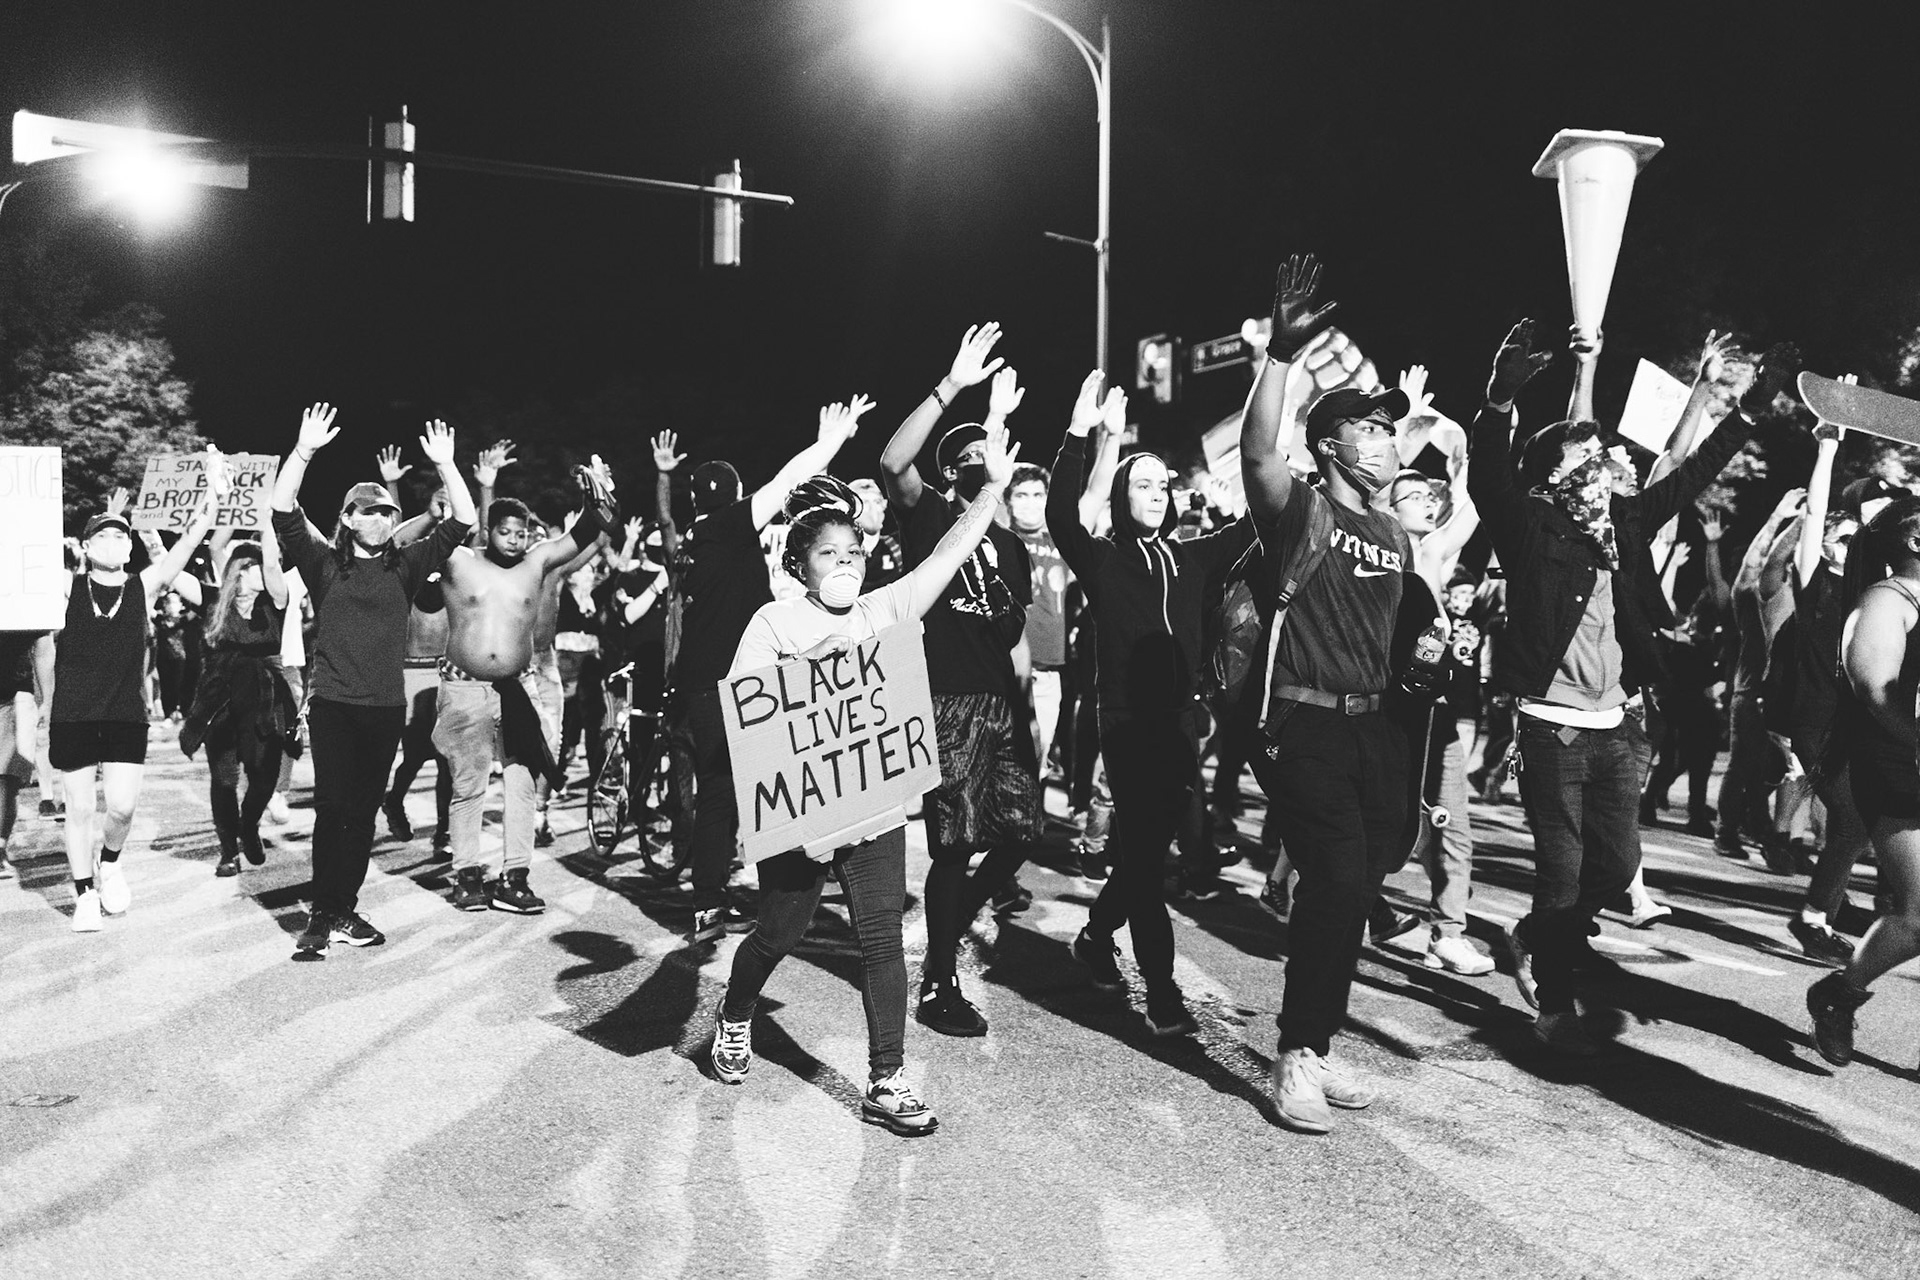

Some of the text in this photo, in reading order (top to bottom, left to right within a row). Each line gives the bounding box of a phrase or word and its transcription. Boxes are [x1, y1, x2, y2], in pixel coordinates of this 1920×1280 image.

[149, 459, 166, 472] I
[239, 462, 277, 472] WITH
[155, 472, 266, 488] MY BCK
[144, 489, 254, 509] BROTRS
[140, 508, 258, 527] and SIERS
[731, 641, 886, 729] BLACK
[788, 687, 887, 755] LIVES
[755, 716, 931, 832] MATTER
